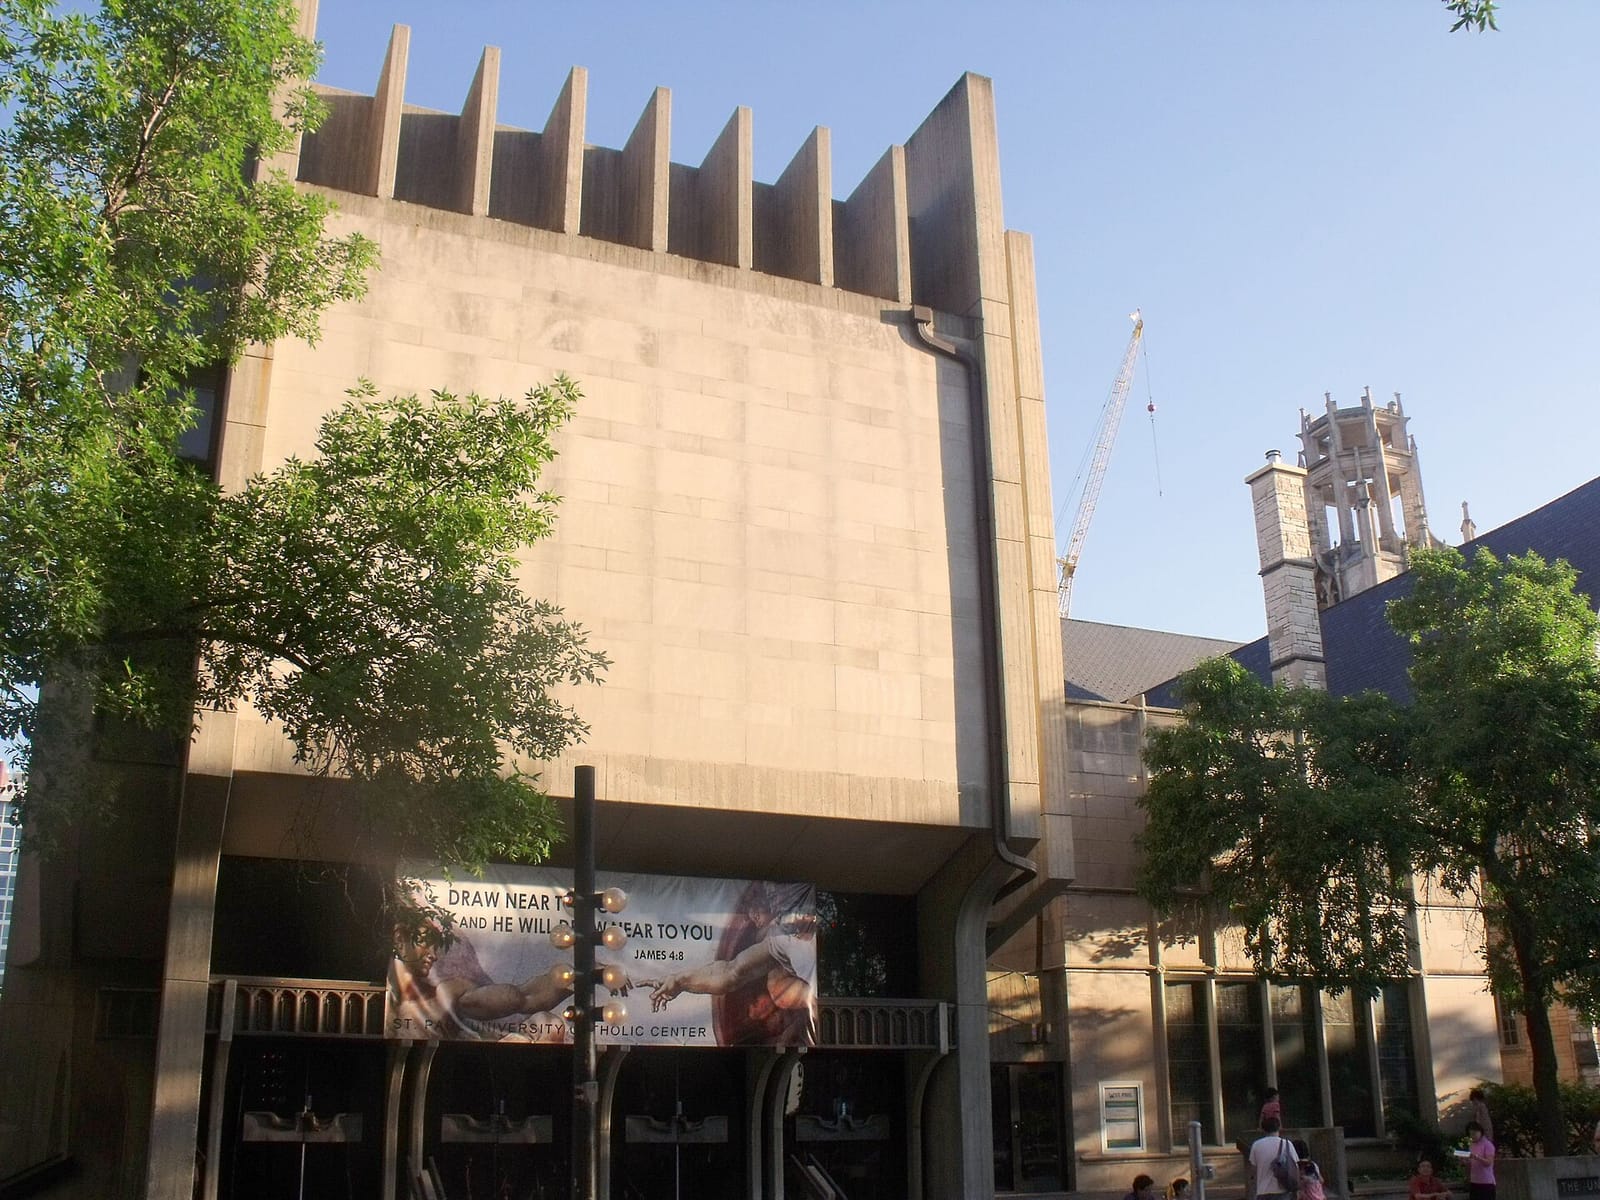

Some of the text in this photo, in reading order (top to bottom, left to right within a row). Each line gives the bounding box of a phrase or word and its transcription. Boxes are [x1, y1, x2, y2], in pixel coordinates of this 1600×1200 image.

[448, 890, 500, 908] DRAW
[505, 892, 550, 911] NEAR
[459, 916, 487, 929] AND
[493, 916, 513, 933] HE
[518, 917, 552, 934] WILL
[612, 921, 653, 939] EAR
[658, 923, 678, 940] TO
[680, 924, 713, 941] YOU
[634, 949, 684, 961] JAMES 4:8
[393, 1018, 416, 1030] ST.
[471, 1021, 565, 1035] UNIVERSITY
[569, 1024, 644, 1037] CHOLIC
[650, 1025, 706, 1038] CENTER
[1561, 1180, 1579, 1192] THE
